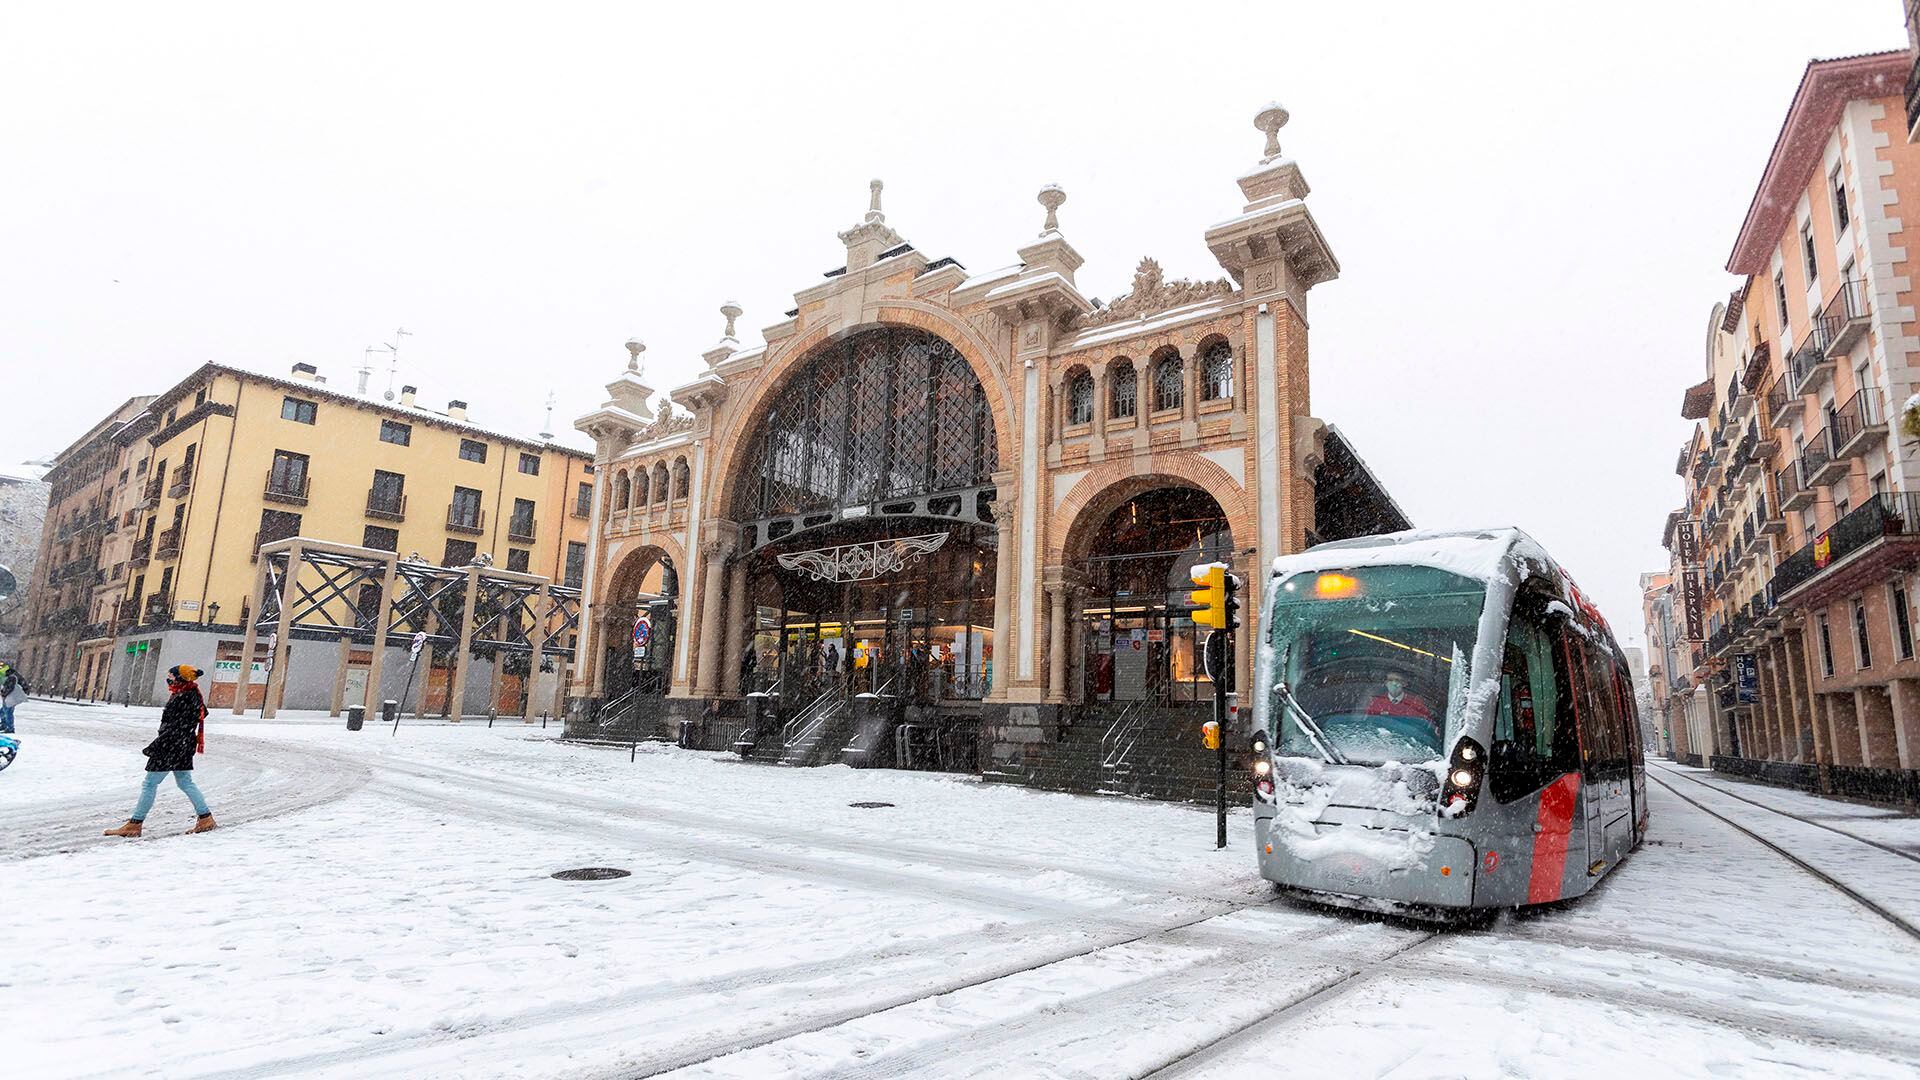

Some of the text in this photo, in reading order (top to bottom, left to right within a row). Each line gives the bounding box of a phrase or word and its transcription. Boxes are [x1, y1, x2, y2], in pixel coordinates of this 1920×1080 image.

[1682, 525, 1699, 638] HOTEL HISPANIA
[1737, 656, 1747, 687] HOTEL
